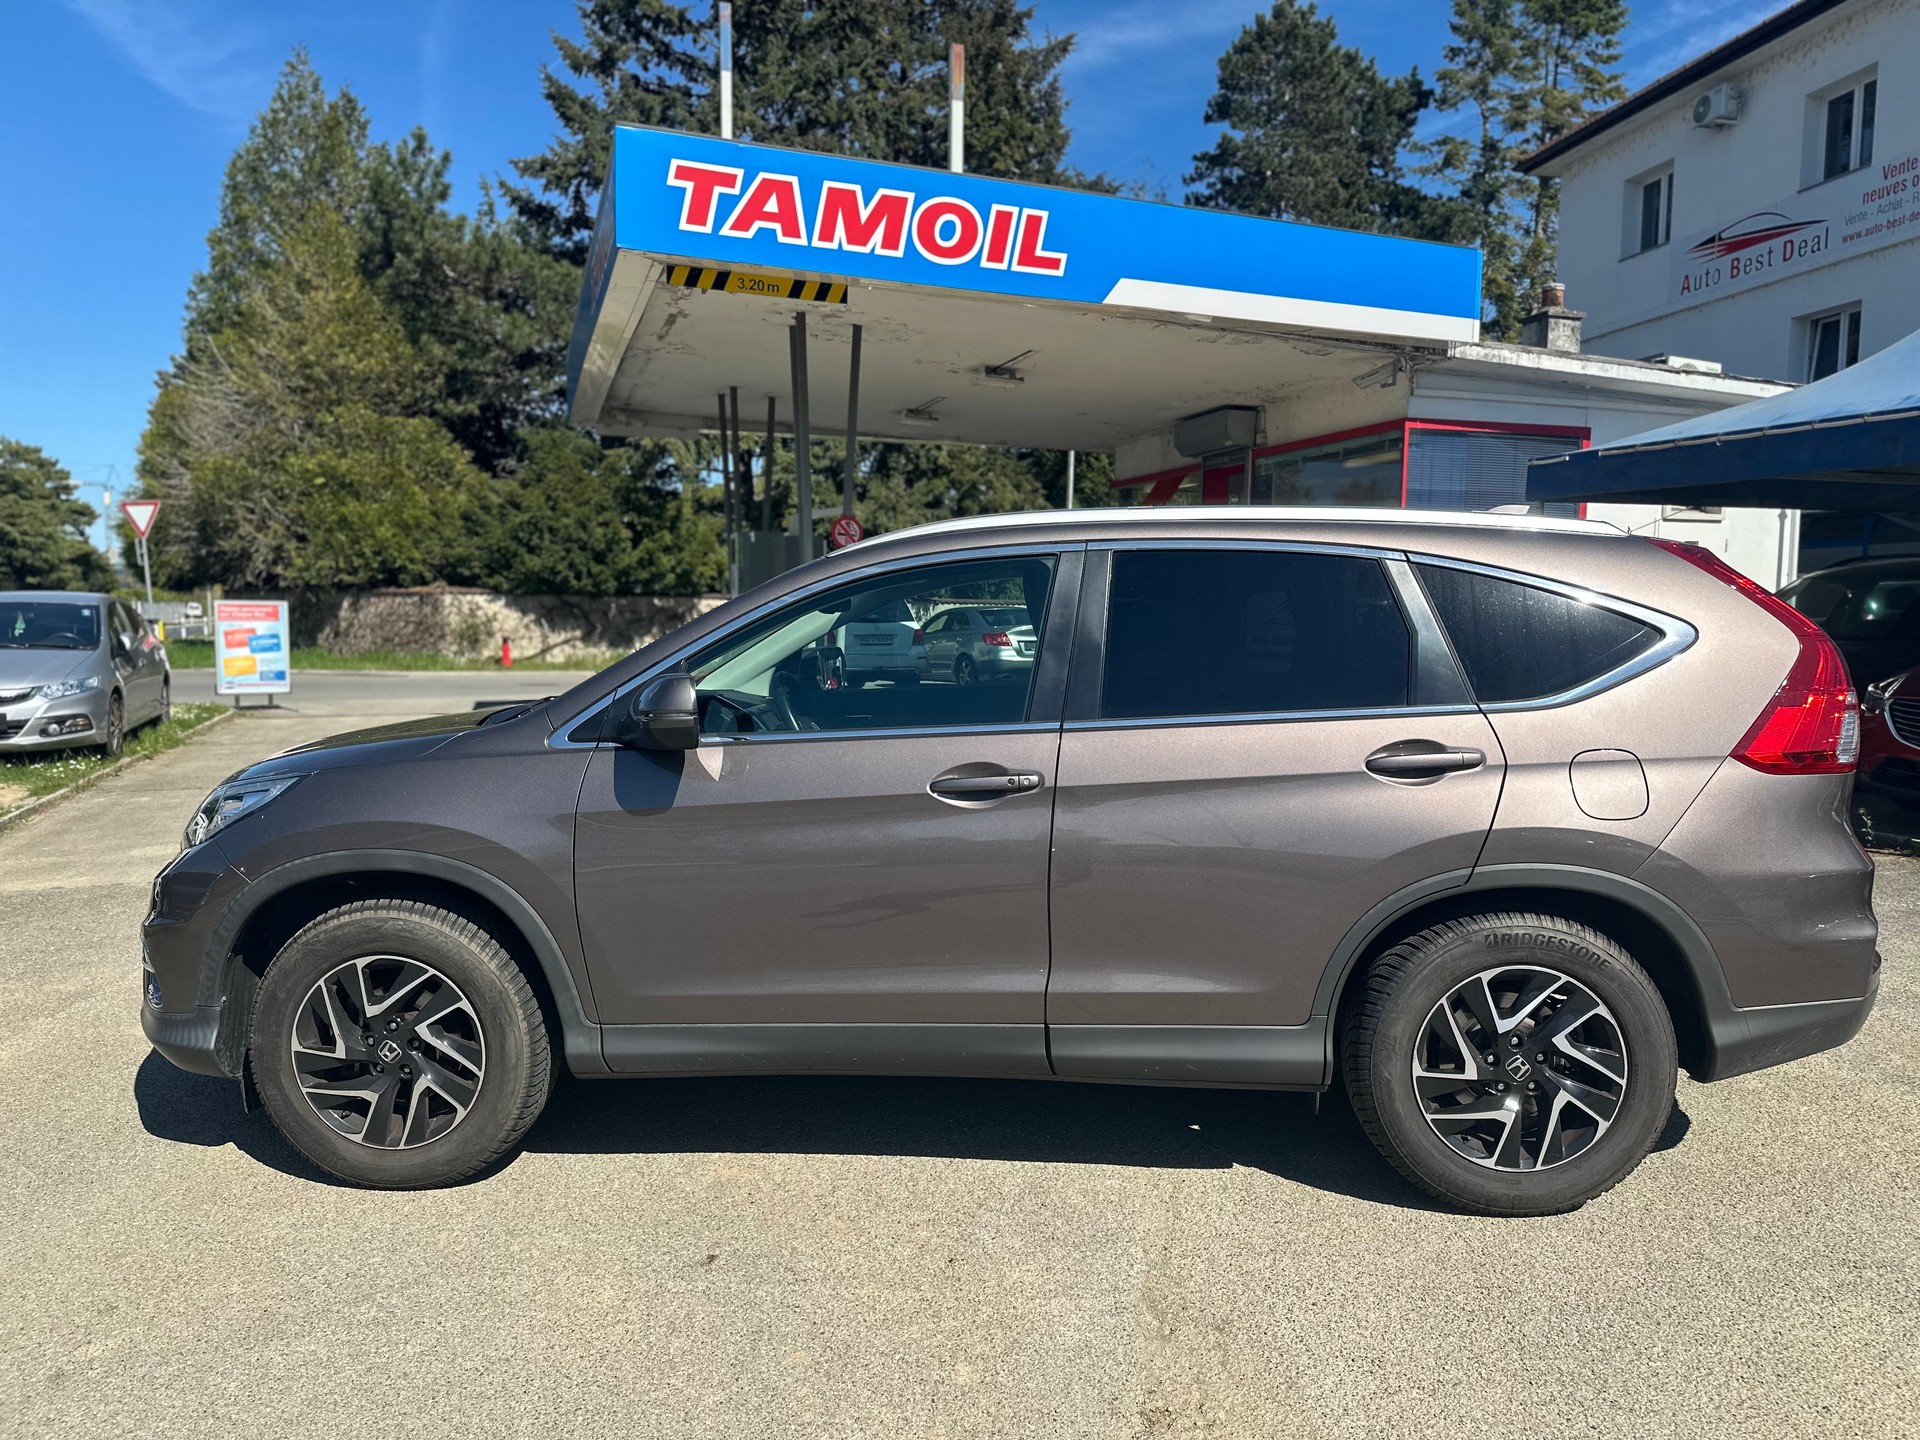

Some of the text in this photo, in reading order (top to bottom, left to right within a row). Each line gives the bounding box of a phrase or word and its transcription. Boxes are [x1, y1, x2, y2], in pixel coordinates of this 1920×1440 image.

[1882, 157, 1919, 180] Vente
[1862, 178, 1908, 205] neuves
[666, 158, 1069, 276] TAMOIL
[1844, 210, 1868, 227] Vente
[1876, 197, 1904, 216] Achat
[1681, 227, 1830, 296] Auto Best Deal
[737, 277, 780, 294] 3.20 m
[1483, 931, 1612, 970] BRIDGESTONE
